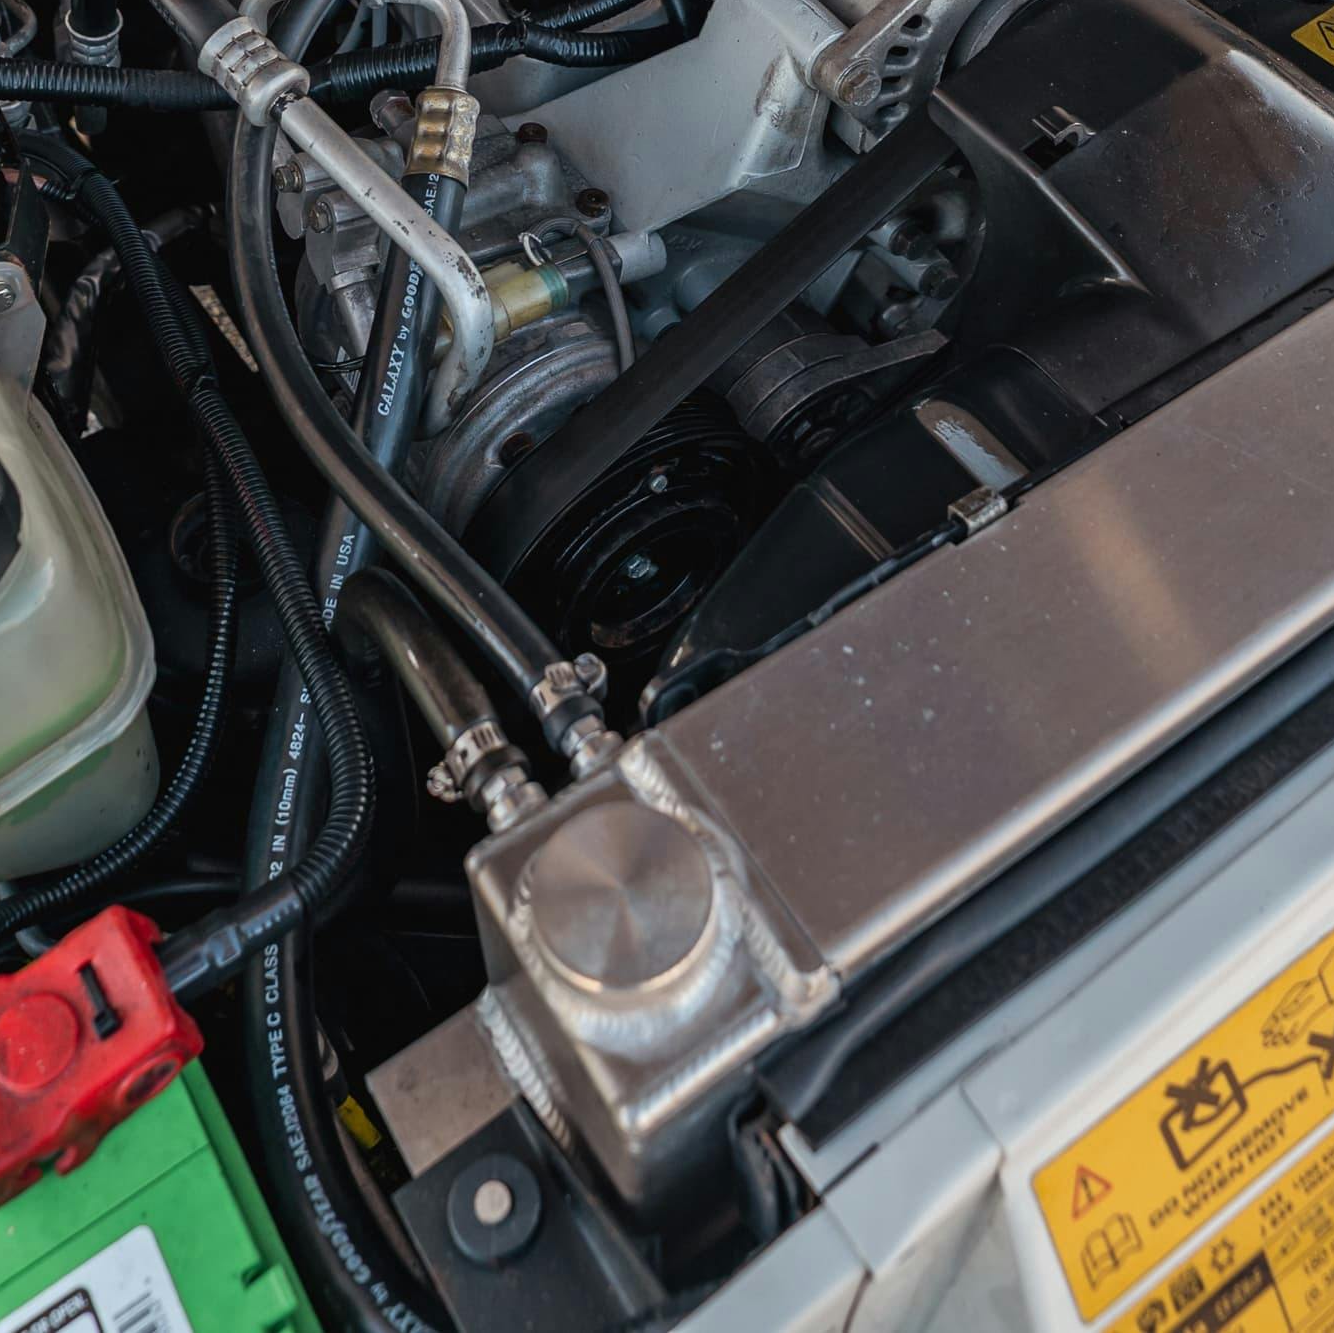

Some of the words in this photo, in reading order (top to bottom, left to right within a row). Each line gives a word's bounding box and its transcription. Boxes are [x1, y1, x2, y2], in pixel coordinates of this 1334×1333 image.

[401, 255, 427, 321] GOOD
[398, 324, 410, 343] by
[378, 345, 405, 418] GALAXY
[337, 532, 357, 566] USA
[332, 569, 345, 591] IN
[322, 593, 340, 632] ADE
[275, 766, 298, 826] (10mm)
[272, 833, 287, 853] IN
[264, 943, 280, 1005] CLASS
[267, 1012, 281, 1026] C
[268, 1028, 287, 1077] TYPE
[278, 1084, 314, 1172] SAEJ2064
[1148, 1197, 1178, 1229] DO
[1182, 1161, 1224, 1199] NOT
[1227, 1086, 1310, 1158] REMOVE
[1182, 1163, 1246, 1218] WHEN
[1246, 1126, 1287, 1164] HOT
